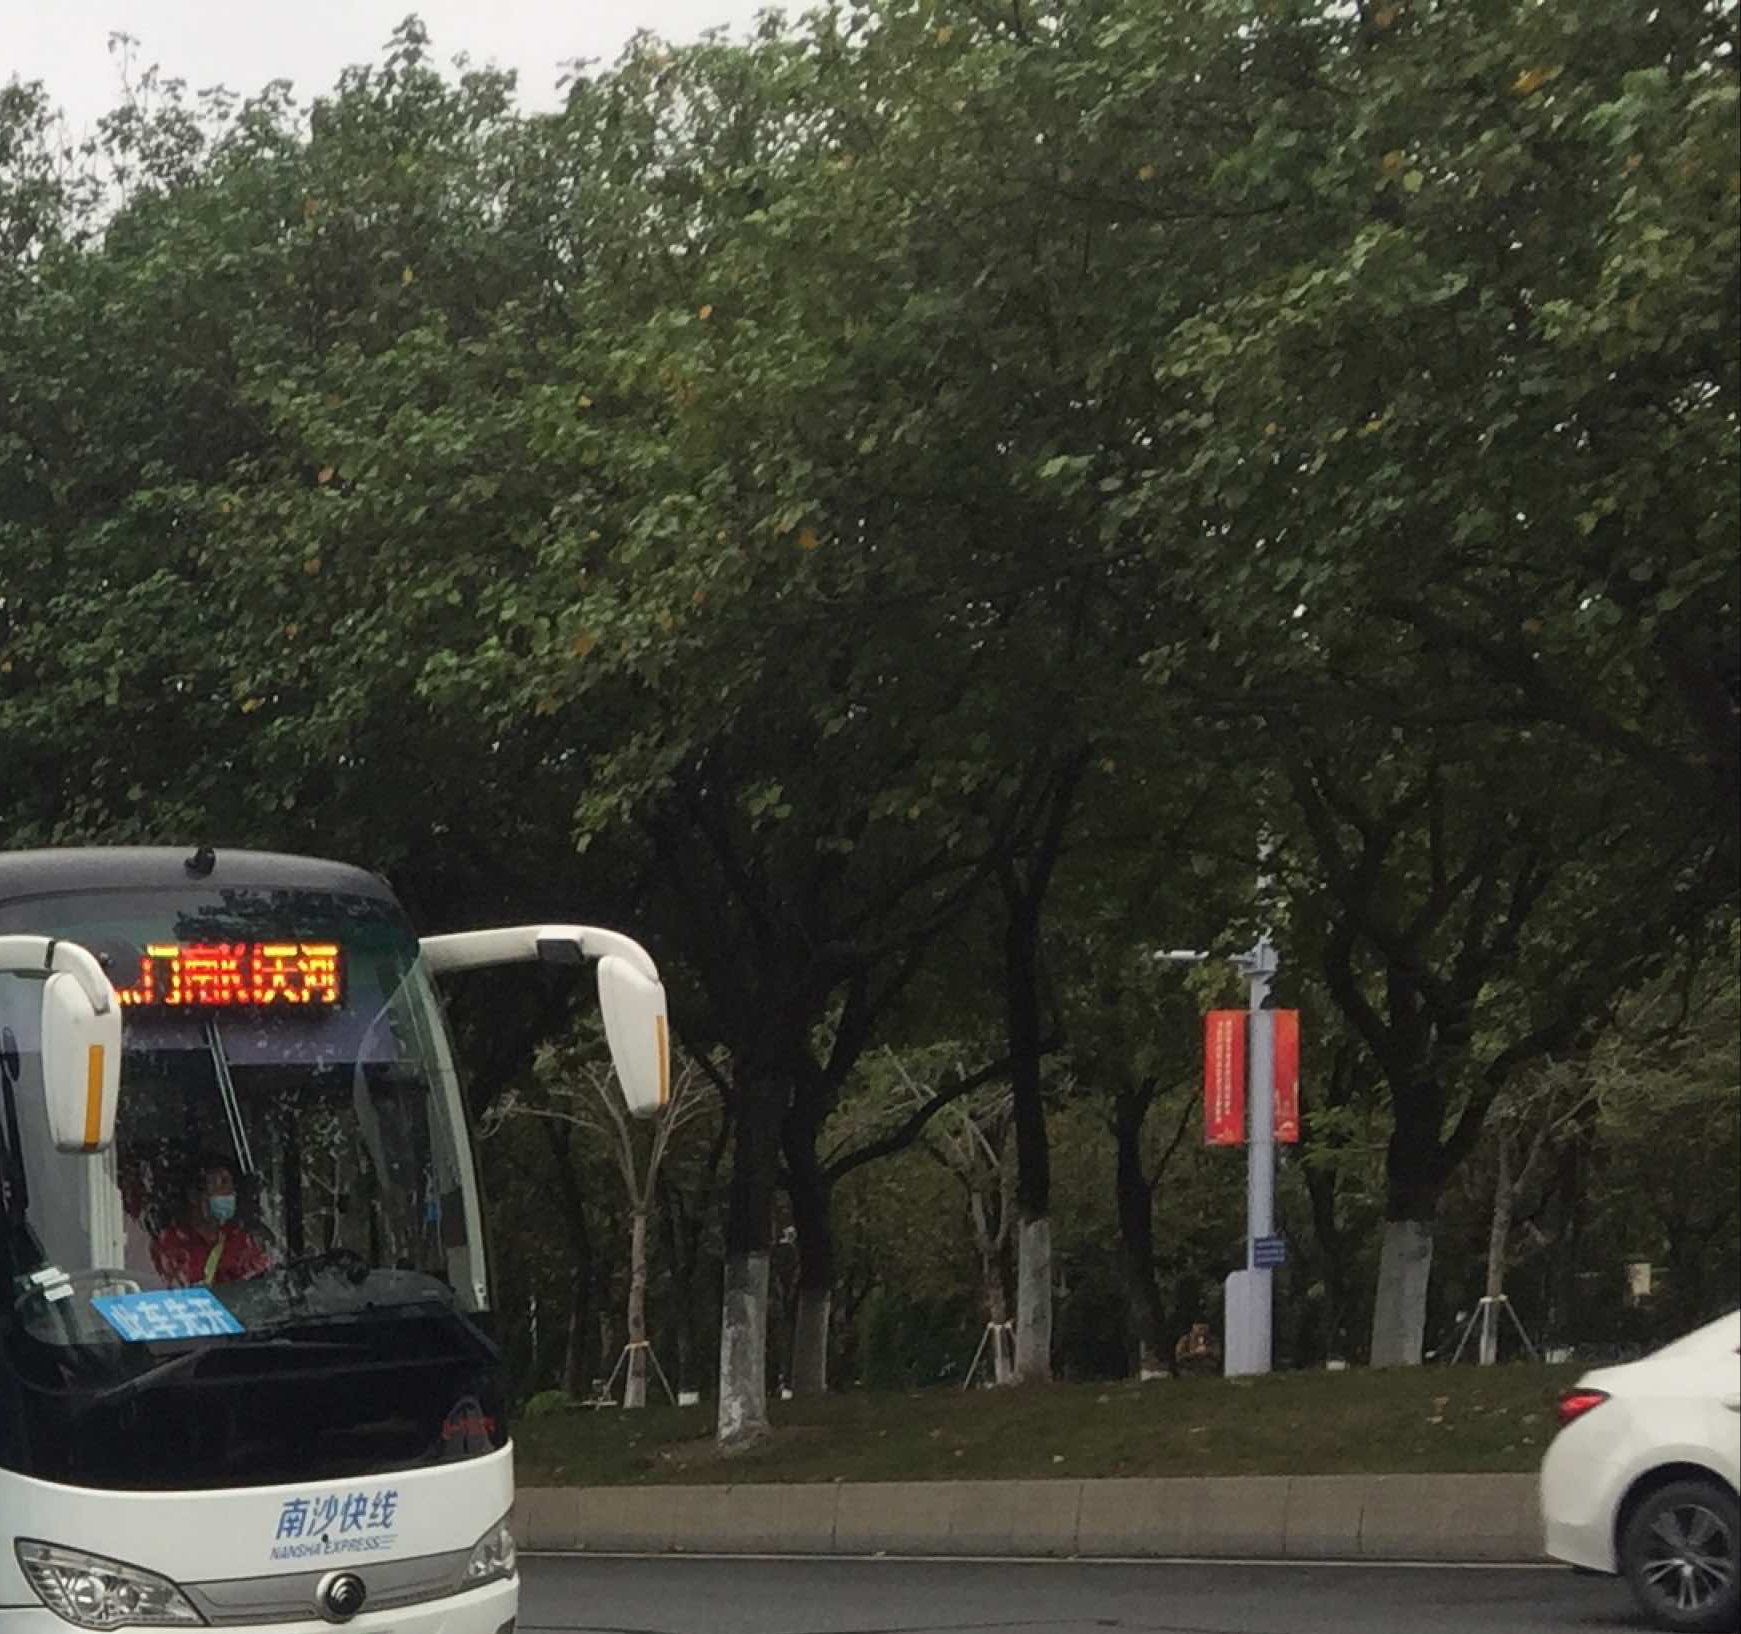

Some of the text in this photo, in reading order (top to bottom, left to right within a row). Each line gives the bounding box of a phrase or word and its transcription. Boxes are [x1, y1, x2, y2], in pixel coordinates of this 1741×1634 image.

[109, 1298, 232, 1340] 此车先开
[276, 1488, 398, 1540] 南沙快线
[270, 1536, 381, 1561] NANSHA EXPRESS
